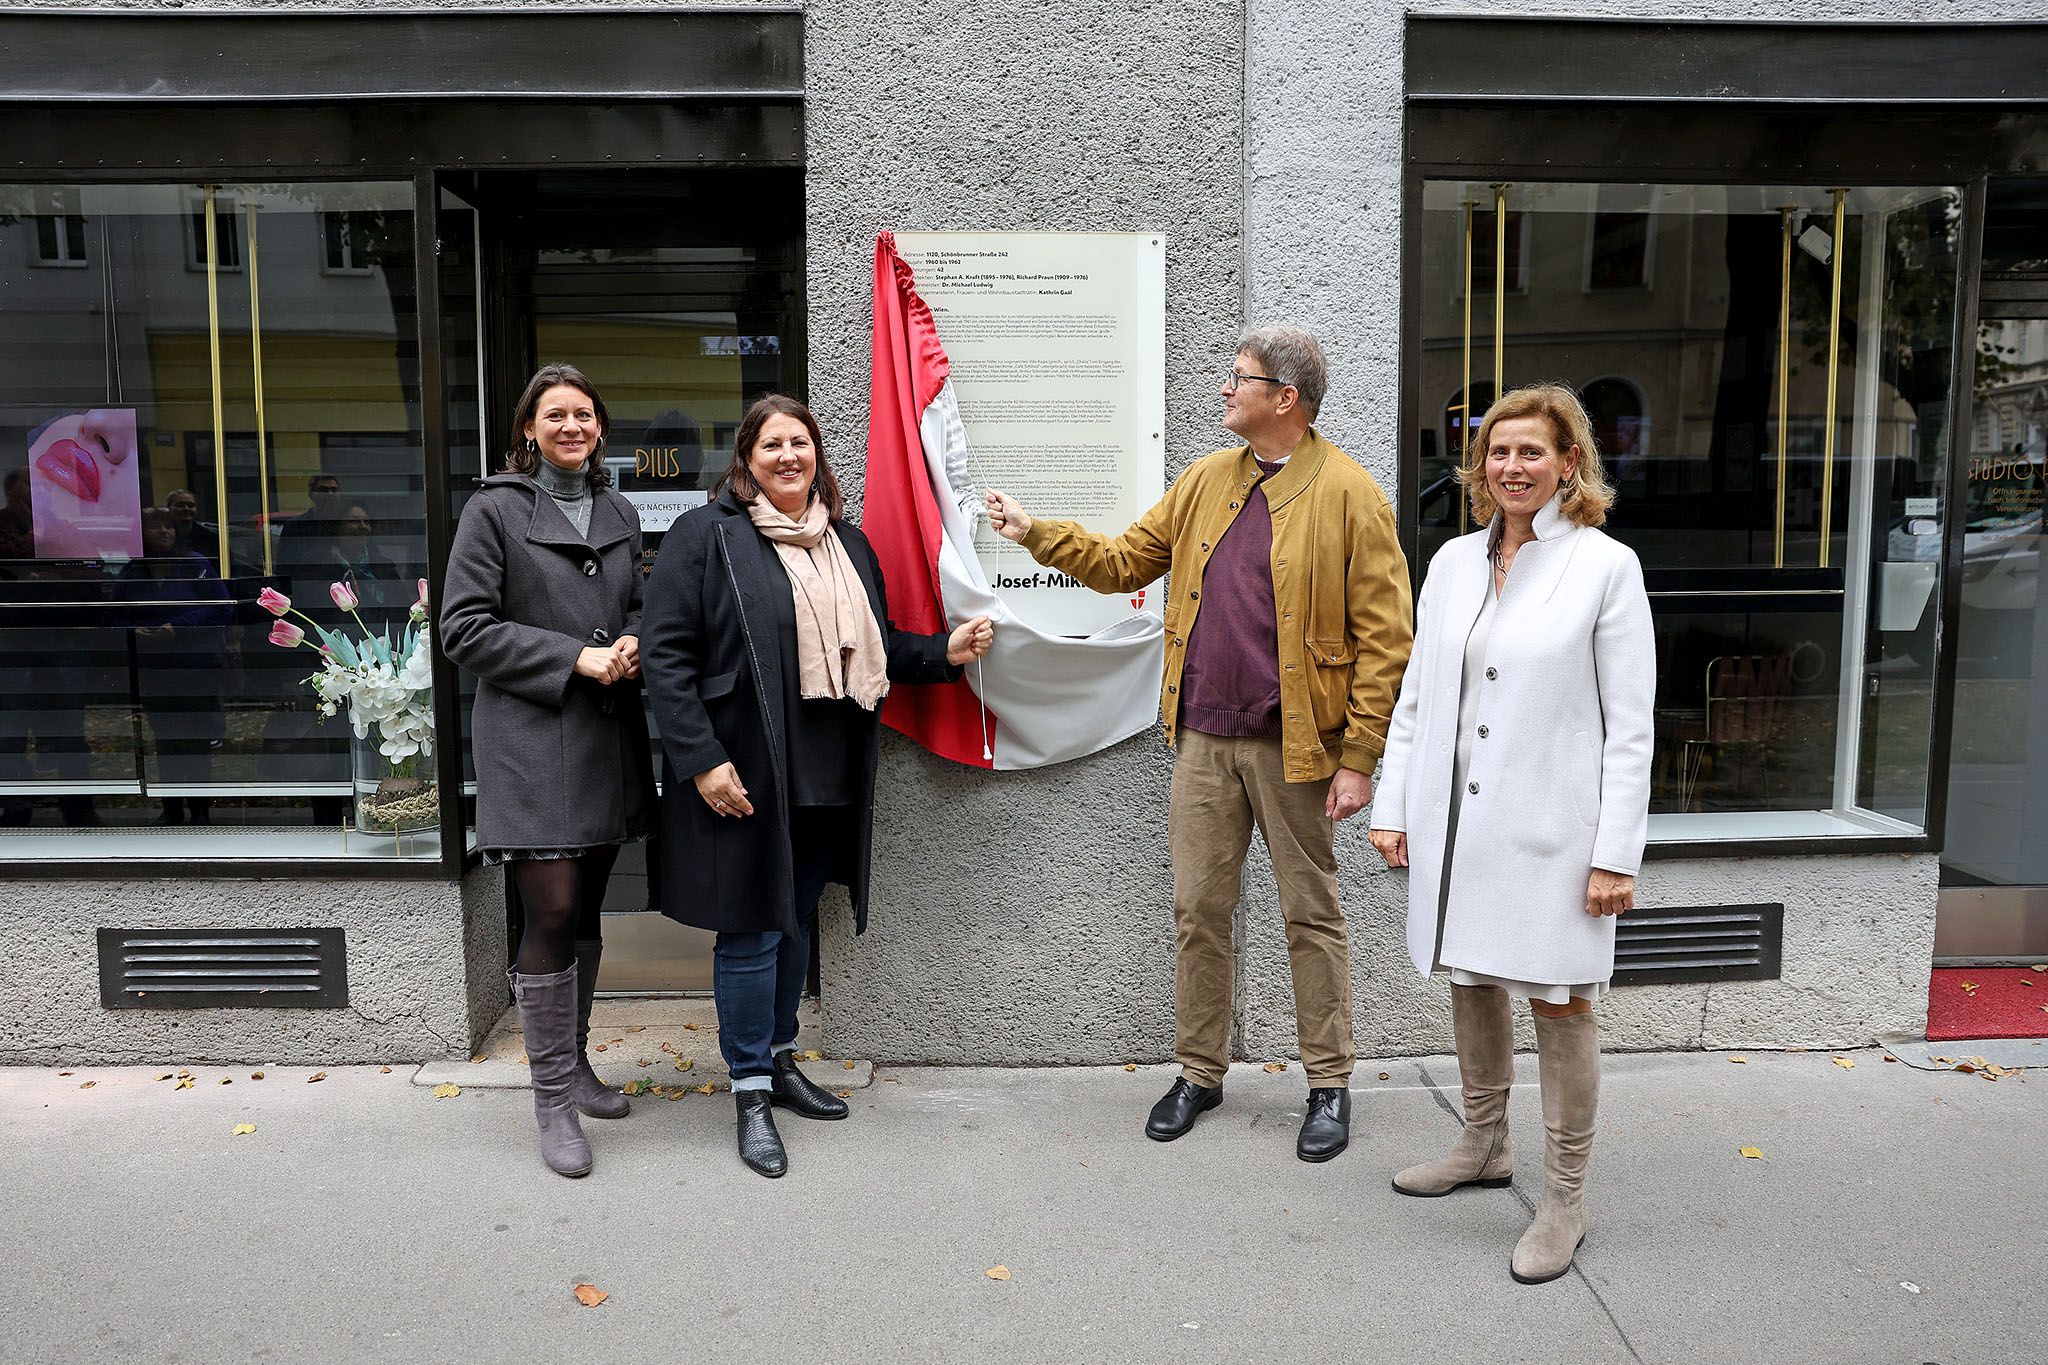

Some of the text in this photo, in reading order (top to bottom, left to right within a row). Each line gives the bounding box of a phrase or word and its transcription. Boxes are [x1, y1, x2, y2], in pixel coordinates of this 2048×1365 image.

[973, 282, 993, 290] Ludwig
[635, 448, 680, 478] PIUS
[647, 502, 681, 511] NÄCHSTE
[991, 573, 1086, 588] Josef-Mik
